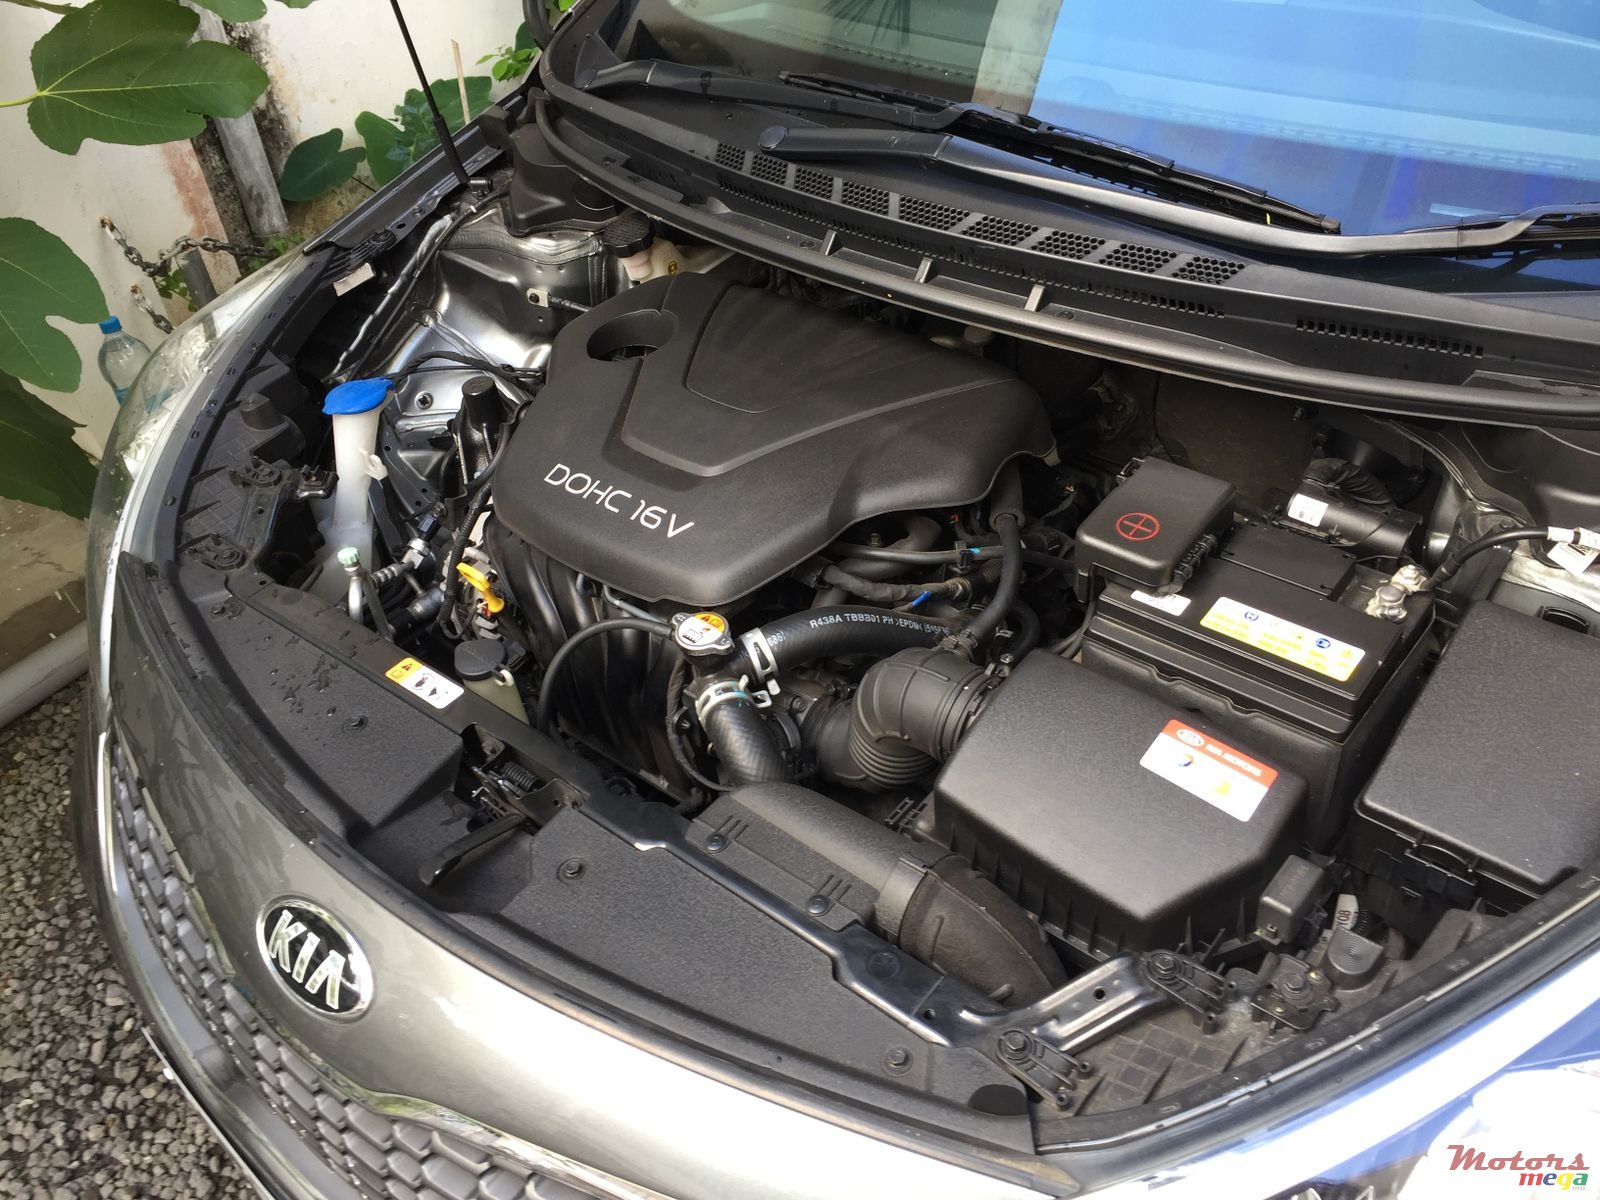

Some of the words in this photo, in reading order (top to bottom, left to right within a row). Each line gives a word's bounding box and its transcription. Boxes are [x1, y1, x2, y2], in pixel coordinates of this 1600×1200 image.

[544, 463, 632, 513] DOHC
[630, 500, 695, 538] 16V
[809, 614, 843, 629] R438A
[268, 909, 346, 1009] KIA
